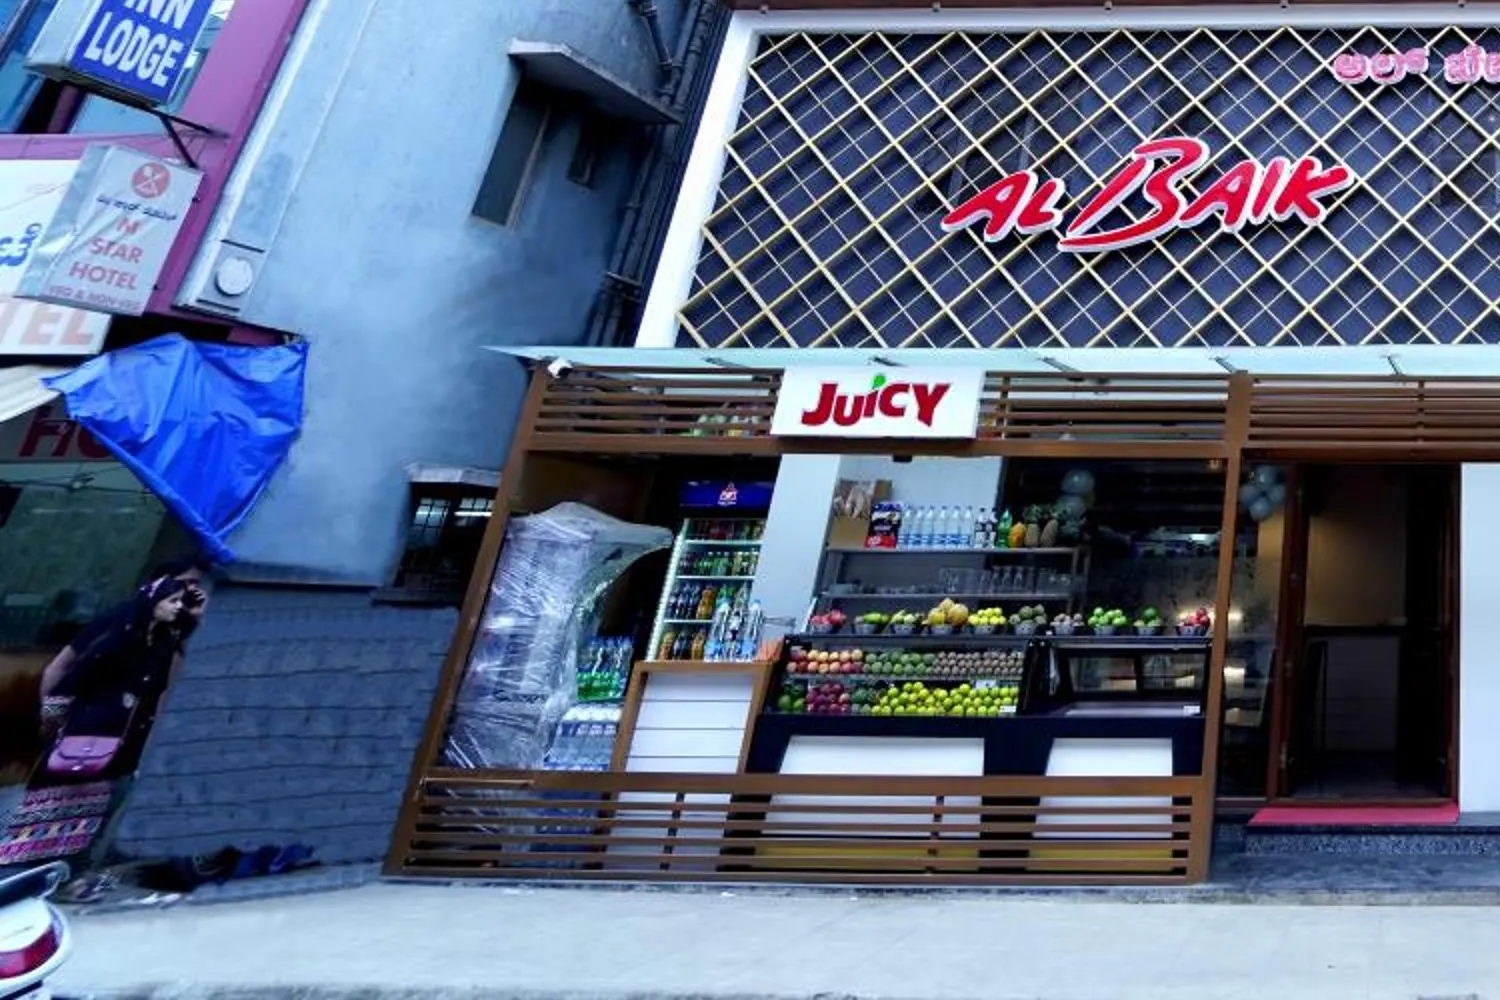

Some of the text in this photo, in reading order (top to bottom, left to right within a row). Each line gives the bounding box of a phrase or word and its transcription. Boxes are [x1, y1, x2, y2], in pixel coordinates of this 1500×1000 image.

[85, 11, 184, 88] LODGE
[941, 170, 1065, 243] AL
[68, 261, 139, 290] HOTEL
[89, 237, 144, 265] STAR
